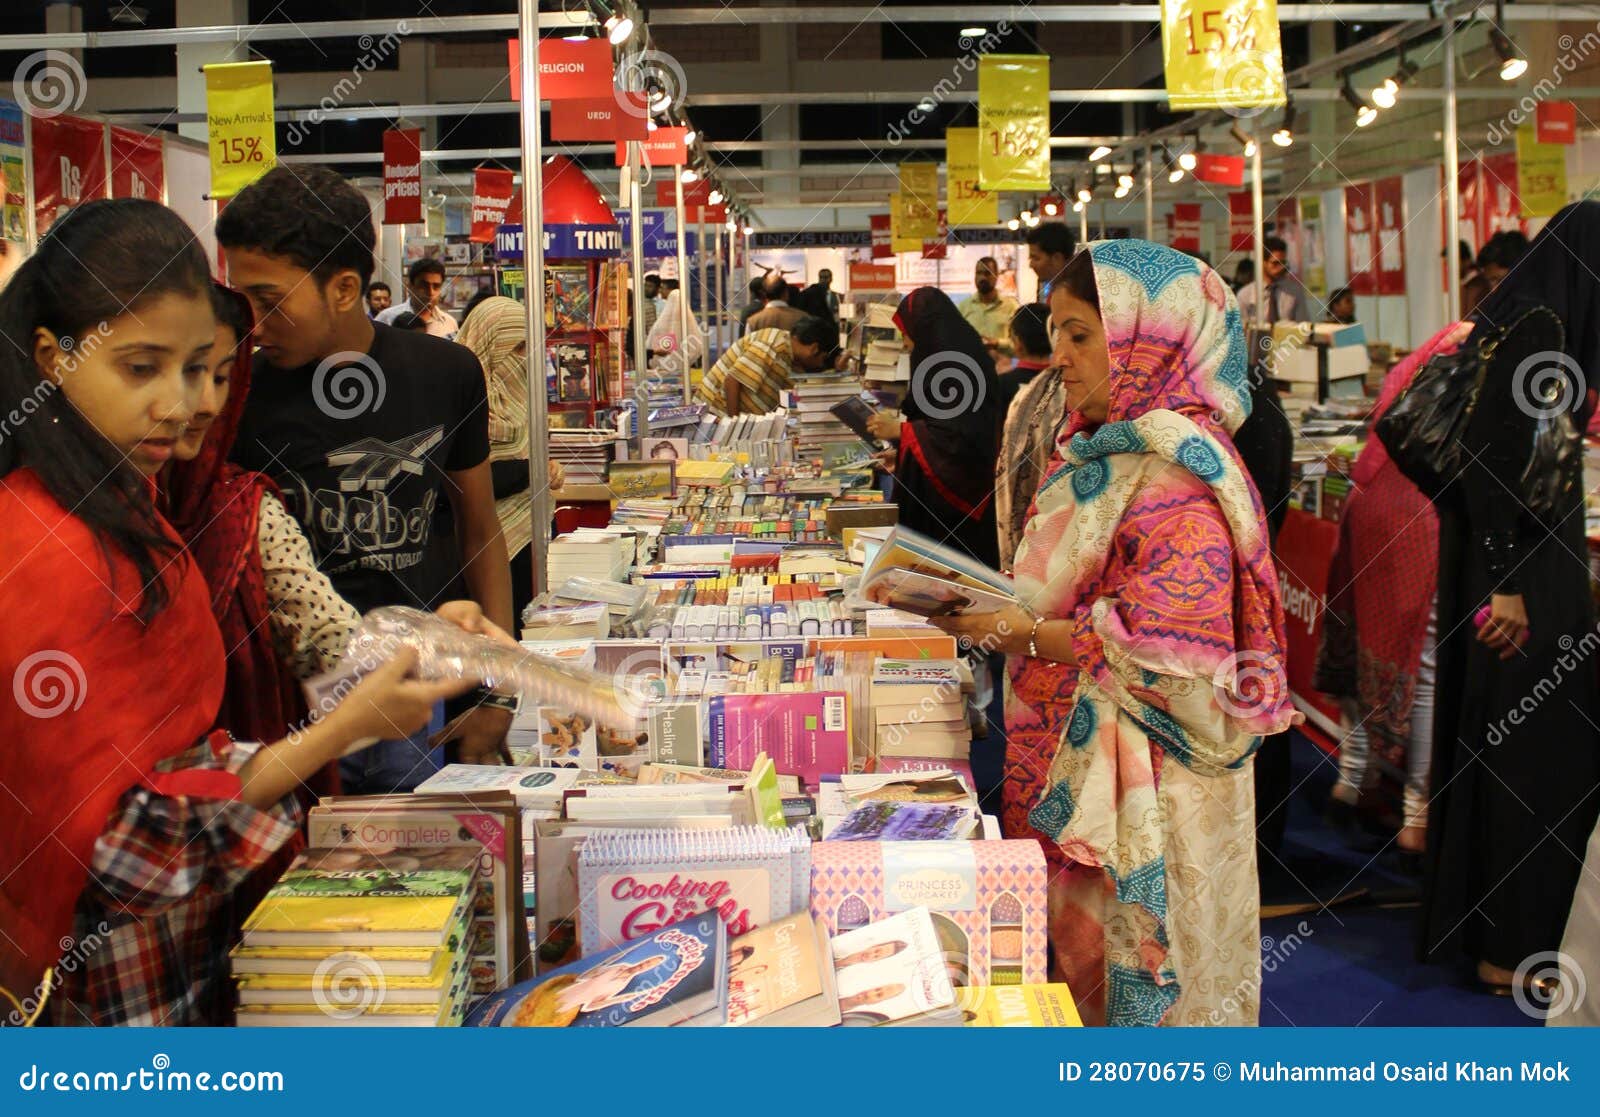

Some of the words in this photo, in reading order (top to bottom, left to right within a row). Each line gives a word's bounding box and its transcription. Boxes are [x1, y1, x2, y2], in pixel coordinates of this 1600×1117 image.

[1179, 8, 1257, 55] 15%
[538, 63, 585, 73] RELIGION
[209, 115, 232, 126] New
[233, 111, 272, 125] Arrivals
[587, 111, 612, 120] URDU
[218, 136, 263, 164] 15%
[990, 130, 1036, 157] 15%
[60, 155, 81, 201] Rs
[385, 180, 420, 200] prices
[954, 180, 988, 200] 15%
[656, 239, 677, 250] EXIT
[820, 232, 872, 244] UNIVE
[1279, 571, 1317, 635] iberty
[661, 706, 676, 755] Healing
[361, 824, 450, 845] Complete
[368, 889, 450, 897] COOKING
[611, 874, 730, 906] Cooking
[898, 880, 961, 890] PRINCESS
